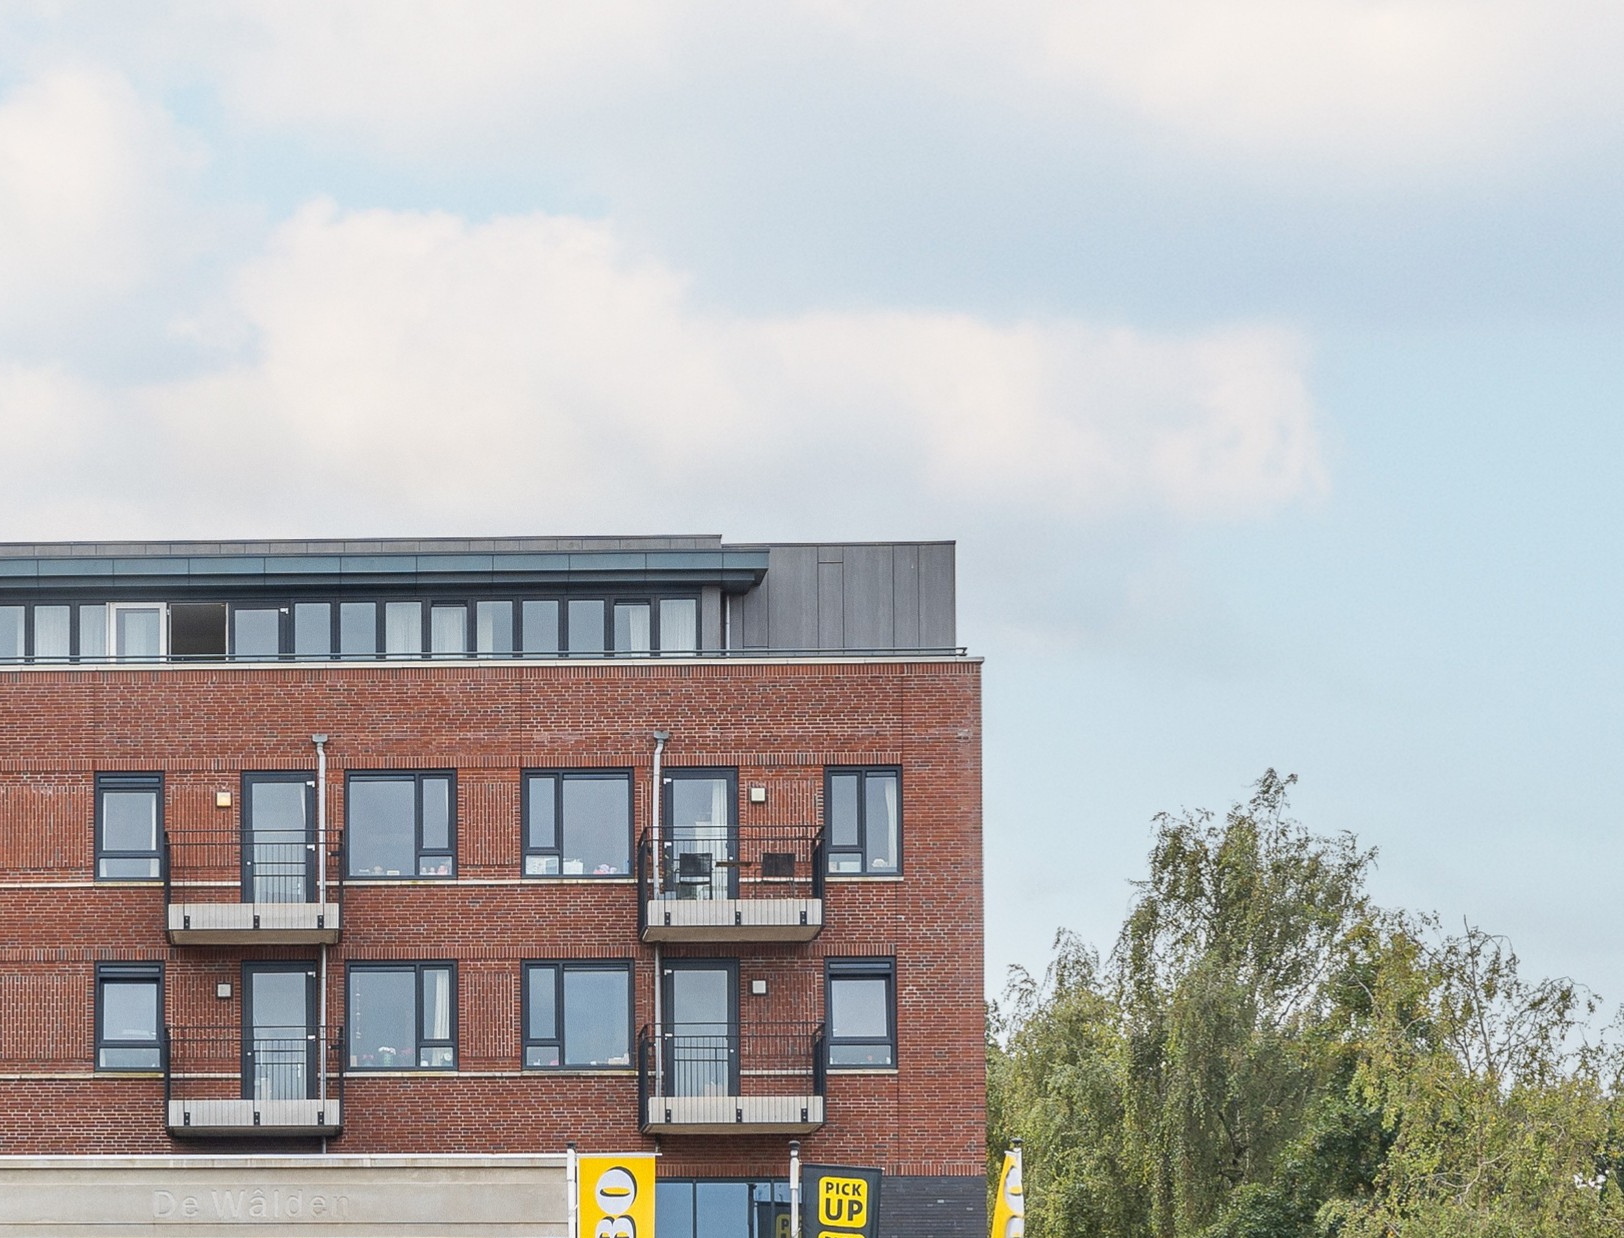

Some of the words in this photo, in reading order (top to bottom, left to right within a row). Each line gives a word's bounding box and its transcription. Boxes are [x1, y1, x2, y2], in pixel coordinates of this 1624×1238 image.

[826, 1183, 862, 1196] PICK
[153, 1189, 199, 1218] De
[825, 1198, 863, 1221] UP
